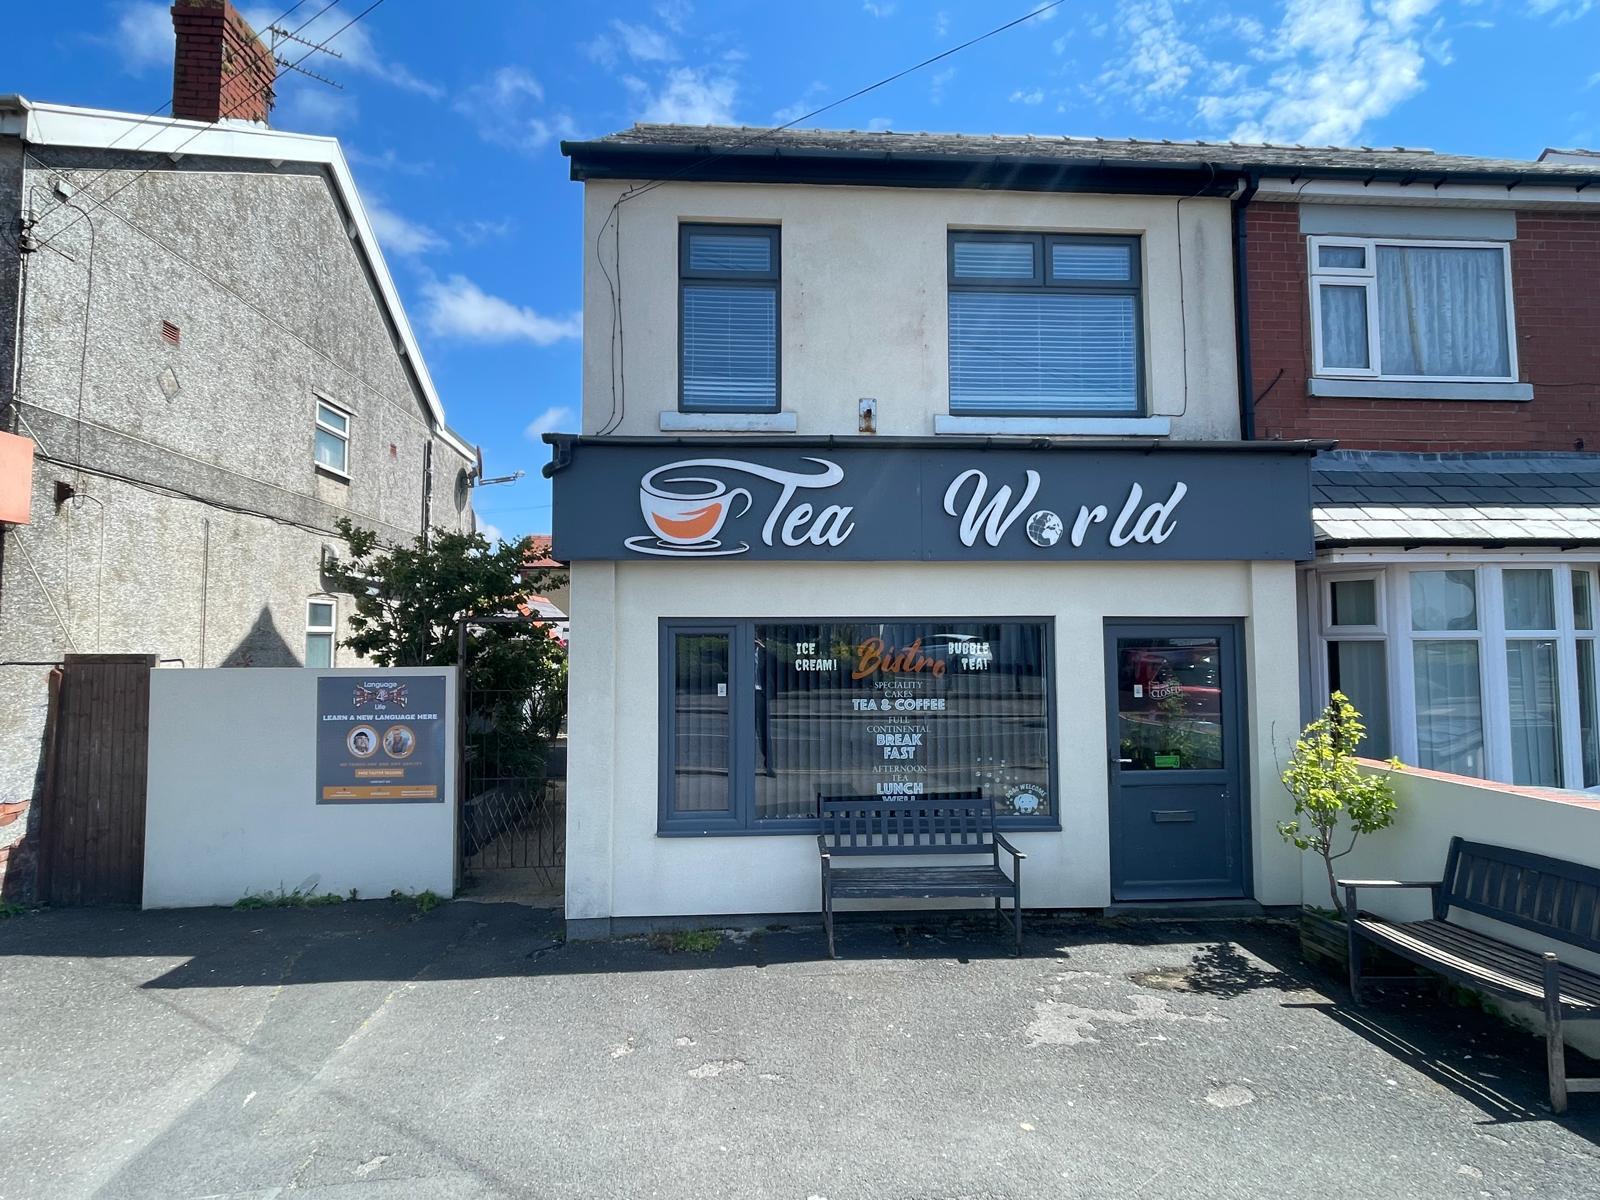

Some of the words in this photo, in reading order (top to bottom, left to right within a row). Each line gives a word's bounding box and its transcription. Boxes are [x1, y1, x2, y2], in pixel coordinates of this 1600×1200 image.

[757, 457, 855, 547] Tea
[796, 642, 816, 655] ICE
[948, 642, 990, 655] BUBBLE
[795, 658, 837, 671] CREAM!
[852, 637, 945, 679] Bistro
[961, 657, 988, 671] TEA!
[364, 681, 398, 689] Language
[874, 681, 923, 690] SPECIALITY
[884, 690, 913, 698] CAKES
[1151, 686, 1181, 698] CLOSED
[852, 699, 878, 711] TEA
[880, 699, 892, 711] &
[894, 699, 946, 711] COFFEE
[888, 716, 910, 724] FULL
[866, 725, 931, 733] CONTINENTAL
[876, 733, 923, 746] BREAK
[883, 746, 916, 760] FAST
[872, 765, 927, 773] AFTERNOON
[892, 774, 909, 782] TEA
[876, 782, 924, 795] LUNCH
[1020, 783, 1047, 797] WELCOME
